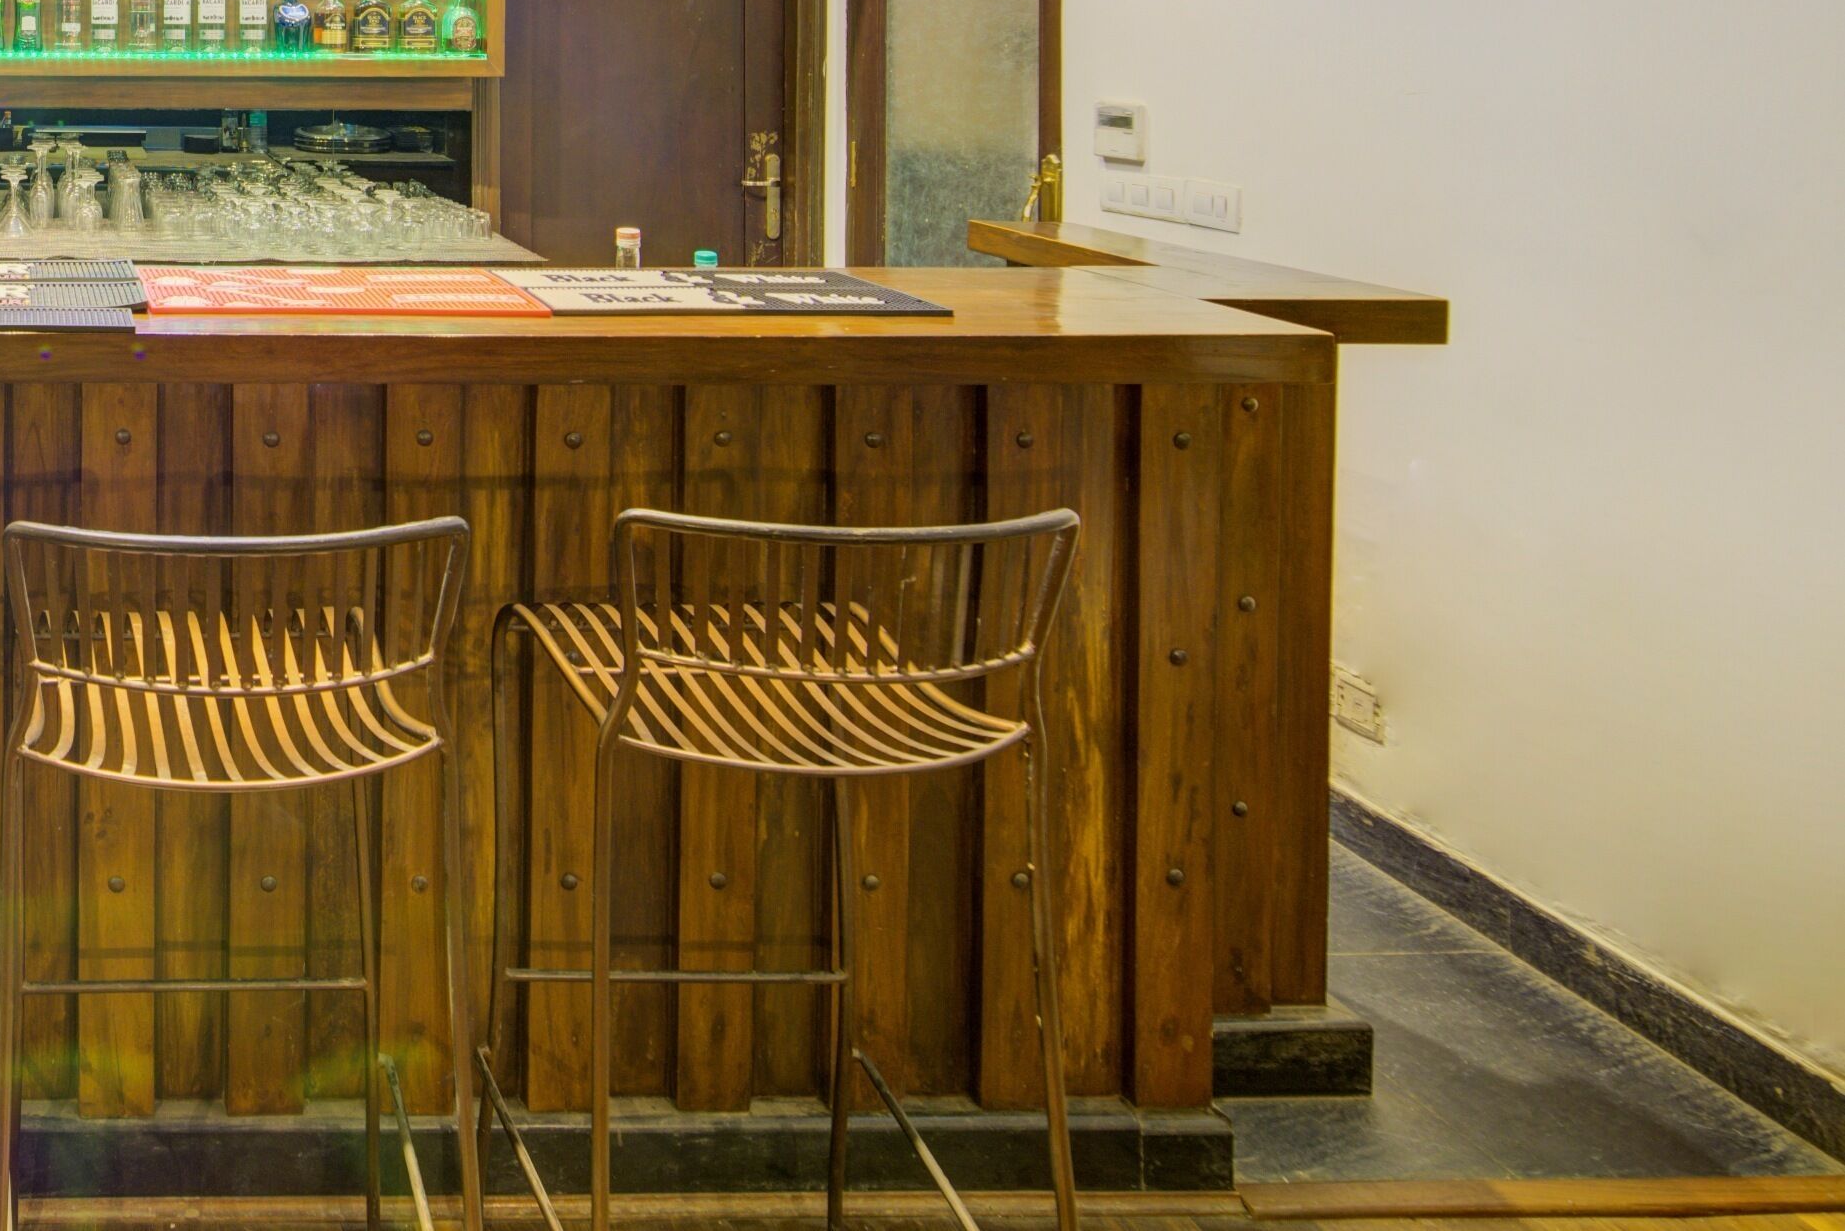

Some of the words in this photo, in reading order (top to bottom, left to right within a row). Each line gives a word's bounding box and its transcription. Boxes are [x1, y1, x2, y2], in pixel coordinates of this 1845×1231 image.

[541, 273, 635, 284] Black
[579, 291, 684, 305] Black
[766, 291, 887, 305] White
